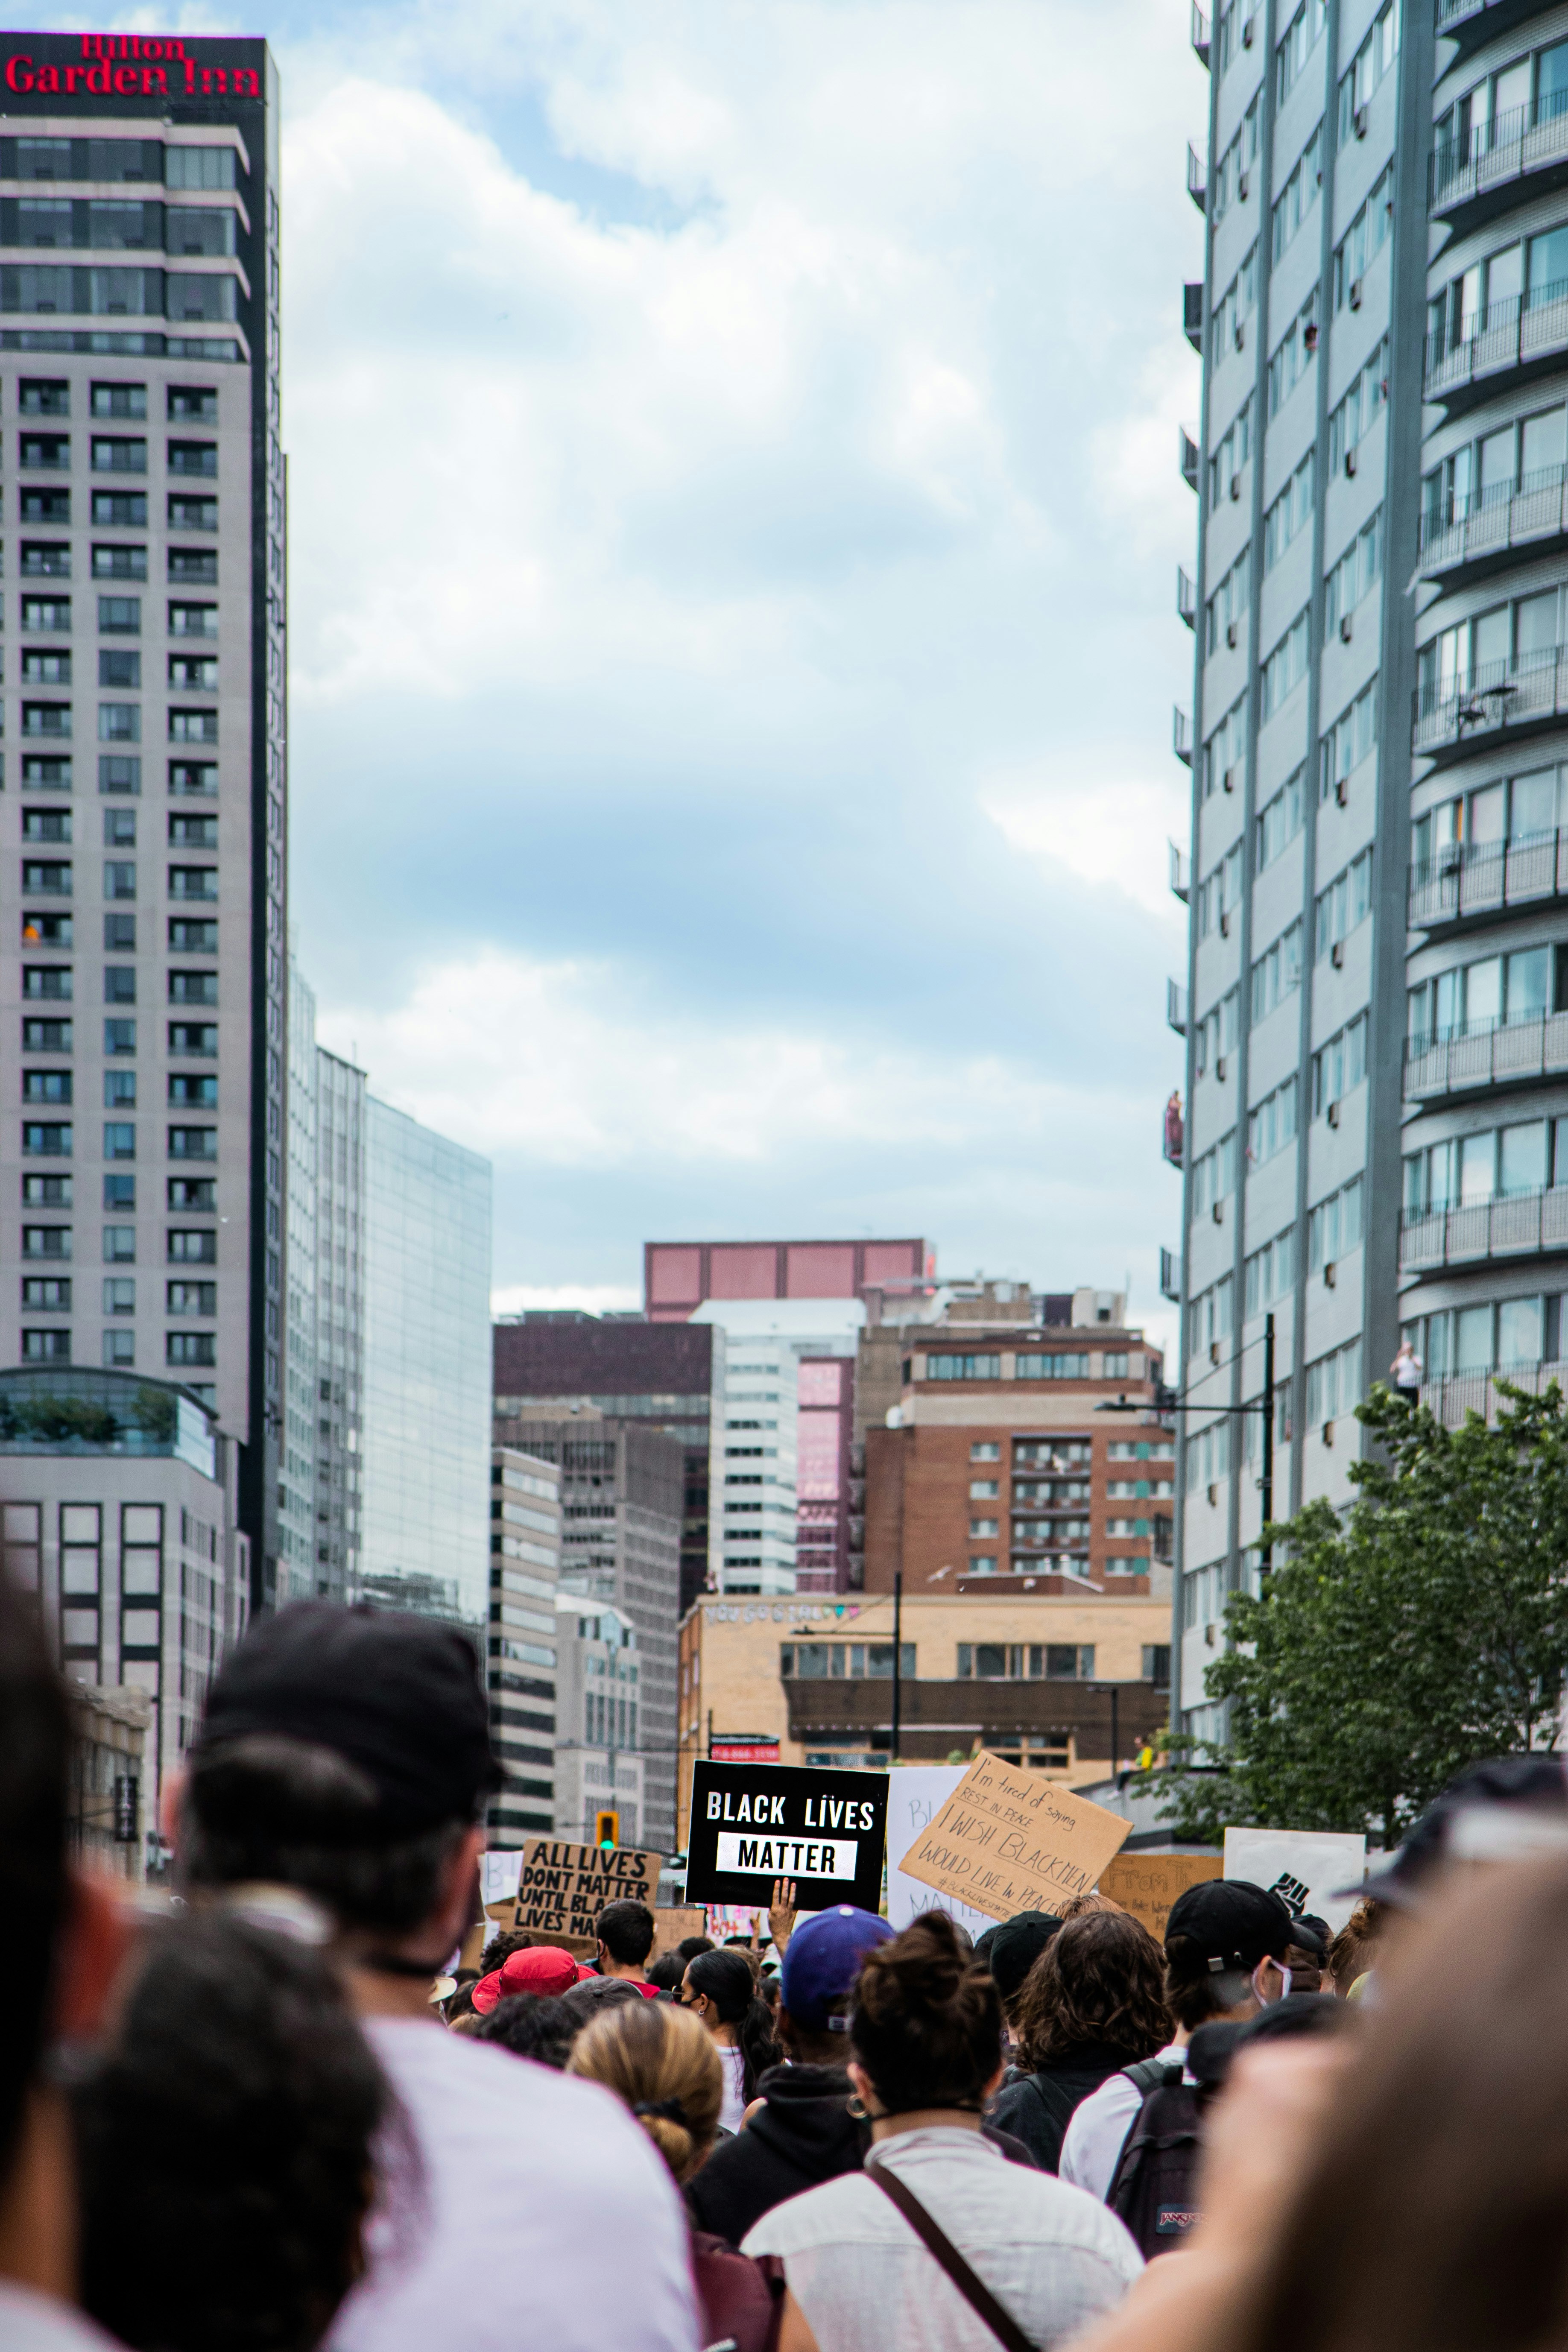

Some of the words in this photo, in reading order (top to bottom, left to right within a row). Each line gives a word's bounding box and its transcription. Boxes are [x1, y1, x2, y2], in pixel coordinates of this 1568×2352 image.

[79, 34, 186, 60] Hilton
[5, 54, 169, 95] Garden
[184, 58, 262, 97] Inn
[707, 1792, 786, 1825] BLACK
[805, 1798, 874, 1831] LIVES
[961, 1787, 989, 1806] REST
[990, 1803, 1003, 1814] IN
[1003, 1808, 1034, 1828] PEACE
[971, 1758, 993, 1787] I'm
[998, 1776, 1033, 1802] tired
[1030, 1791, 1053, 1809] of
[1045, 1807, 1076, 1832] saying
[738, 1839, 835, 1874] MATTER
[938, 1803, 955, 1828] I
[949, 1811, 998, 1846] WISH
[998, 1833, 1064, 1878] BLACK
[530, 1842, 574, 1869] ALL
[578, 1846, 648, 1878] LIVES
[918, 1840, 971, 1874] WOULD
[970, 1865, 1006, 1892] LIVE
[1017, 1885, 1059, 1916] PEACE
[518, 1887, 568, 1911] UNTIL
[570, 1893, 606, 1915] BLA
[522, 1866, 574, 1891] DONT
[576, 1873, 649, 1901] MATTER
[937, 1876, 1014, 1919] #BLACKLIVESMATTE
[515, 1906, 566, 1931] LIVES
[1159, 2212, 1205, 2227] JANSPO
